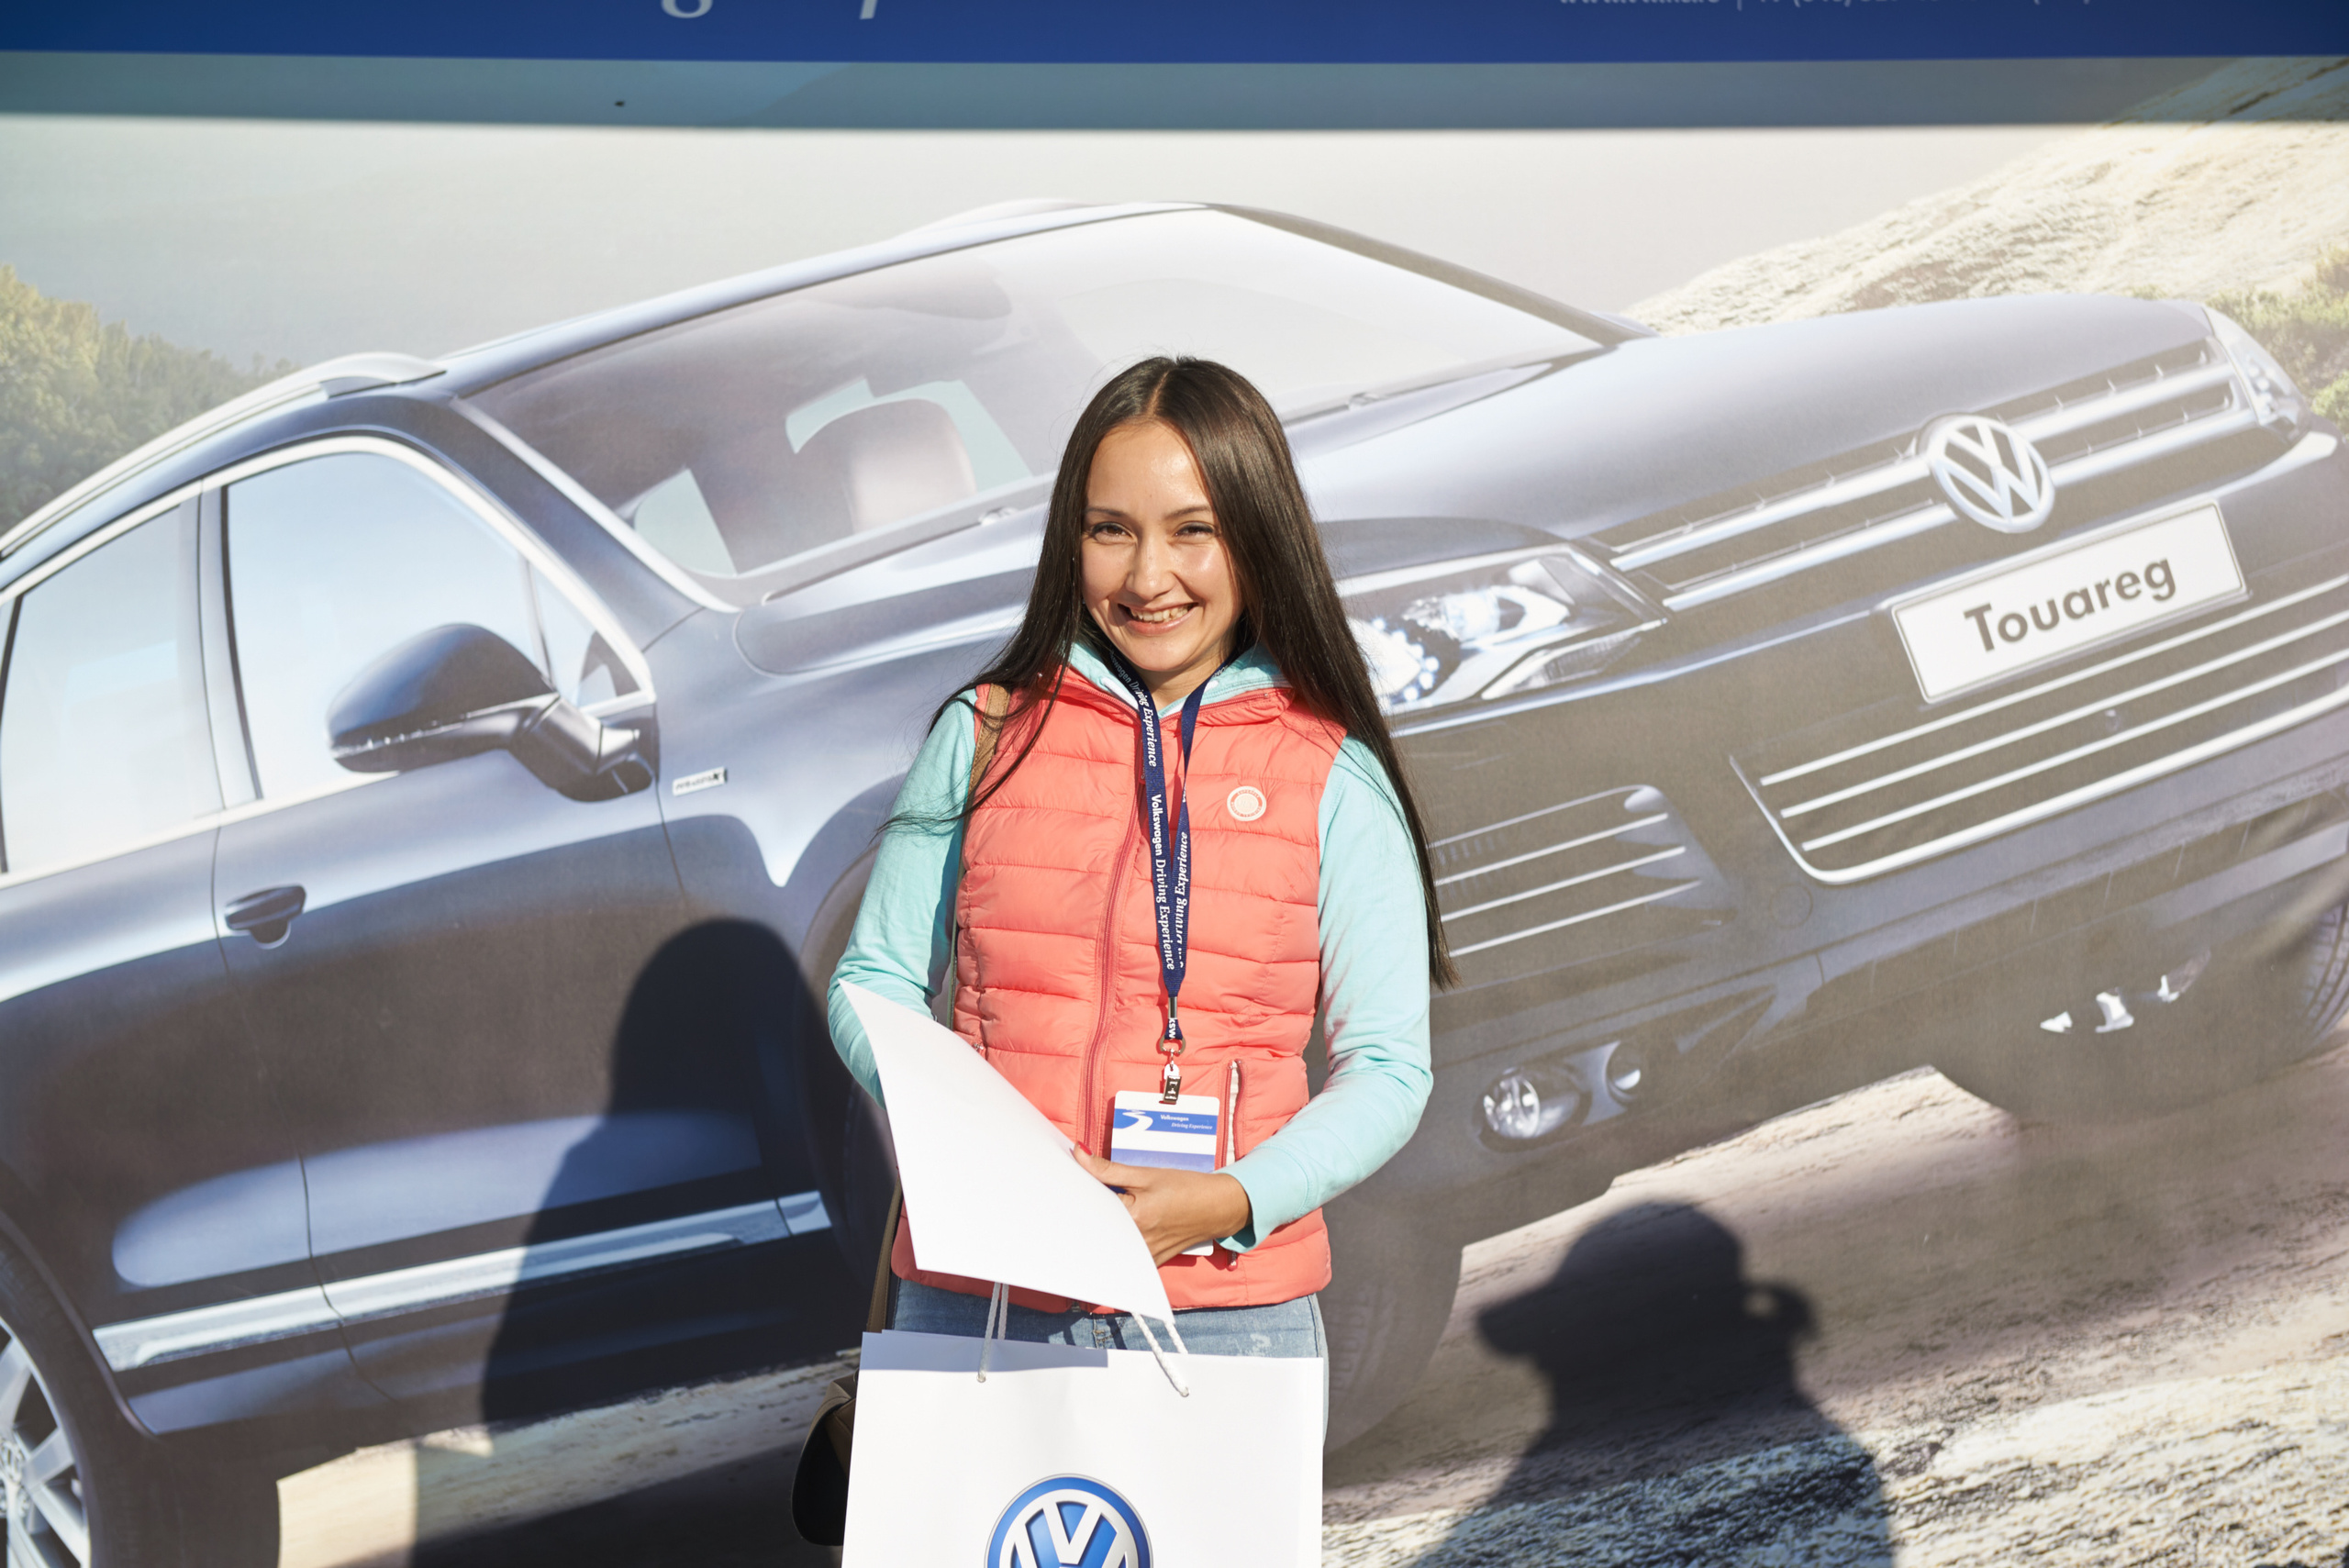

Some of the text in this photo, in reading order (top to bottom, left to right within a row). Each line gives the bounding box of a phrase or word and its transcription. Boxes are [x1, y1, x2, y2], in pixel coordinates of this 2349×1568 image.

[1963, 558, 2176, 653] Touareg
[1142, 707, 1158, 768] Experience
[1151, 794, 1175, 971] Volkswagen Driving Experience
[1174, 831, 1190, 896] Experience
[1160, 1114, 1189, 1122] Volkswagen
